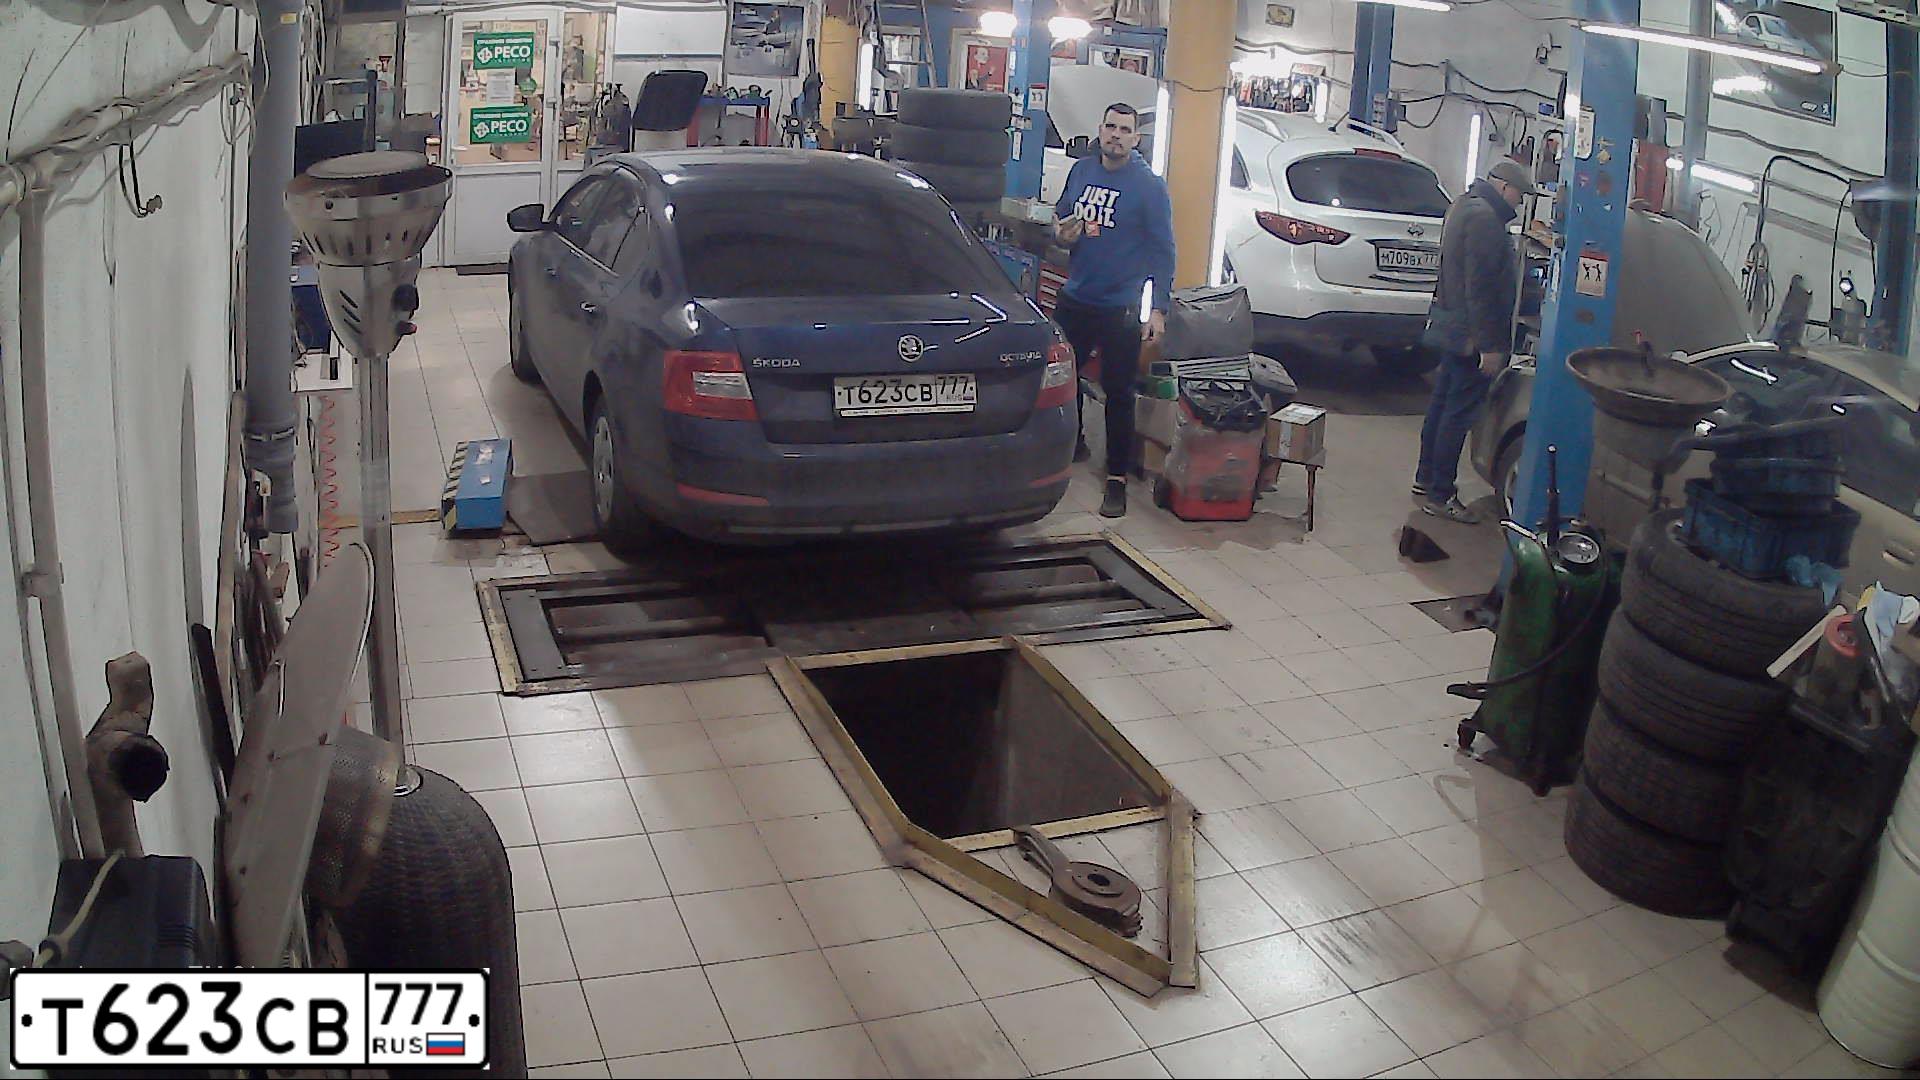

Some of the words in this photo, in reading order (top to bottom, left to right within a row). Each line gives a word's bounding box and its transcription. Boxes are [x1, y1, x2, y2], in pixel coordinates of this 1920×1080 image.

[494, 45, 530, 58] РЕСО
[490, 119, 526, 132] РЕСО
[1078, 185, 1121, 208] JUST
[1073, 201, 1097, 222] DO
[843, 380, 933, 405] Т623СВ
[937, 376, 969, 394] 777
